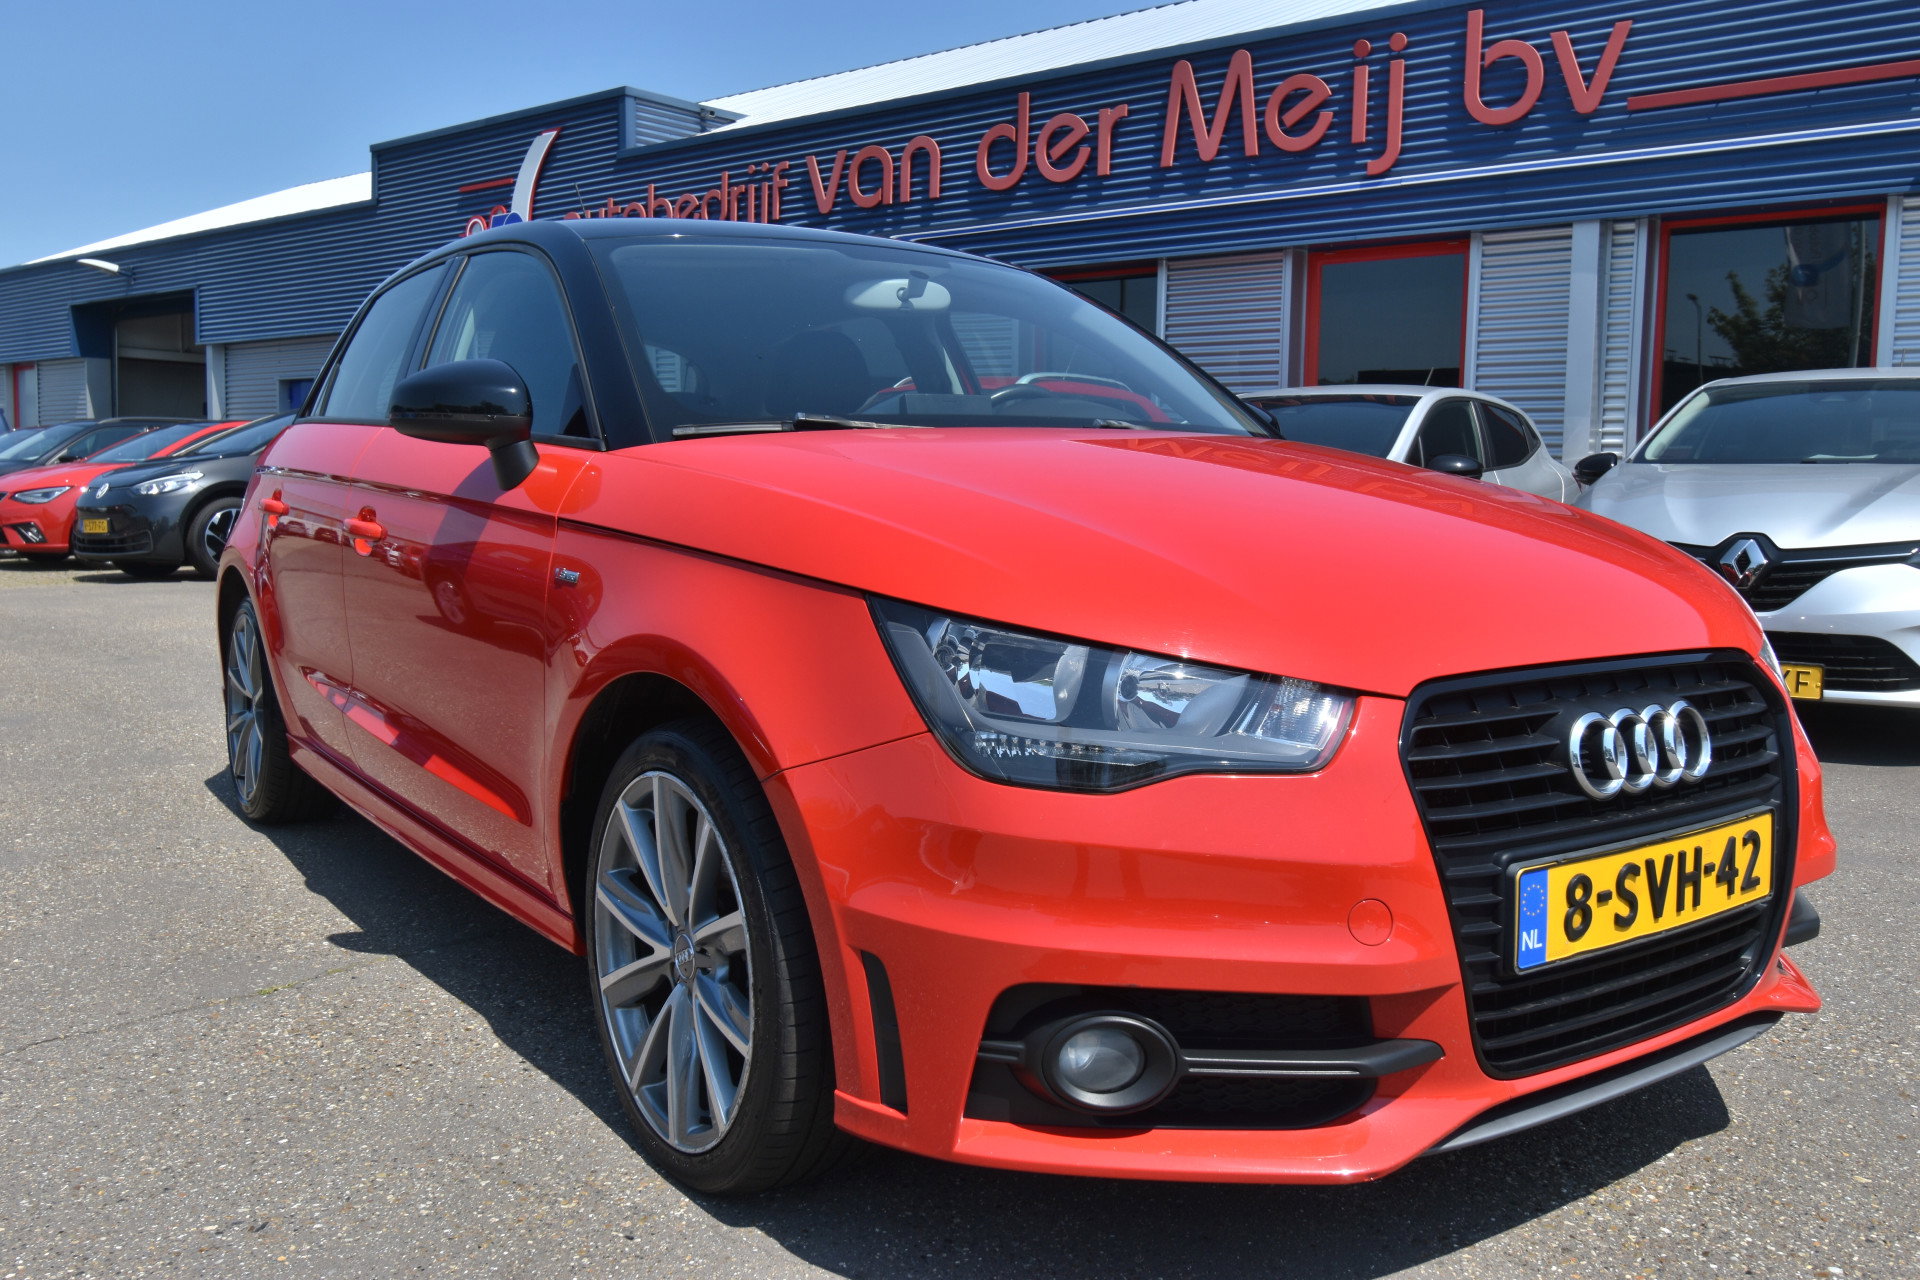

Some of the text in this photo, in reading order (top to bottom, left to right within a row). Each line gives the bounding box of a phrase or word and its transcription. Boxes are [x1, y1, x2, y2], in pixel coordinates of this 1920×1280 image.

[564, 9, 1633, 223] tobedrijf van der Meij bv
[1521, 929, 1543, 951] NL
[1563, 829, 1762, 942] 8-SVH-42
